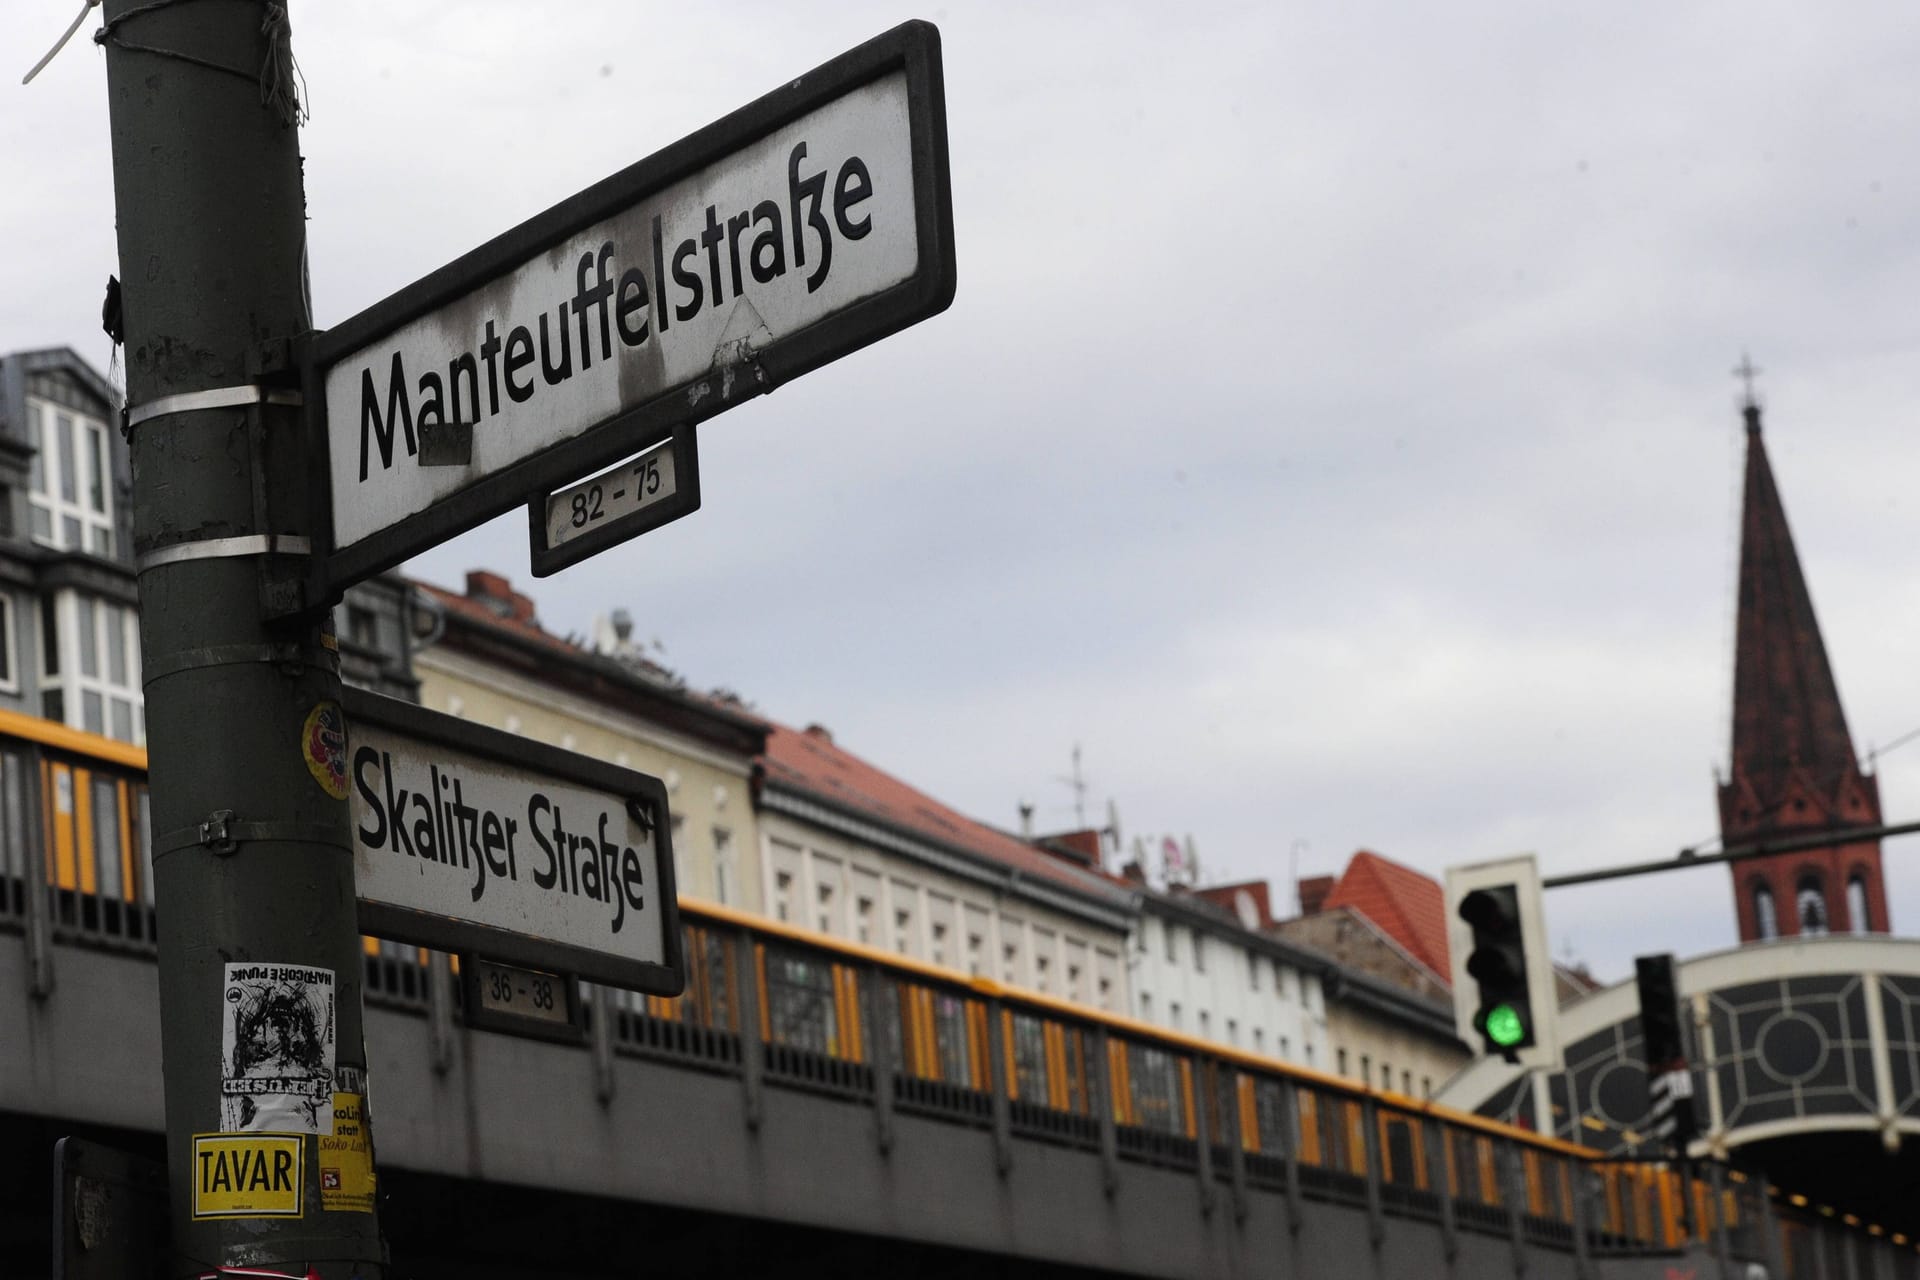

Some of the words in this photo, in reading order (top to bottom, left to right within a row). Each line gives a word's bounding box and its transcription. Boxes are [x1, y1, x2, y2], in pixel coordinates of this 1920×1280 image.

[359, 141, 873, 483] Manteuffelstraße
[571, 485, 604, 528] 82
[633, 458, 659, 501] 75
[353, 746, 518, 902] Skalitzer
[528, 793, 644, 934] Straße
[270, 969, 332, 985] HARDCORE
[490, 972, 512, 1002] 36
[532, 980, 554, 1010] 38
[199, 1150, 293, 1193] TAVAR
